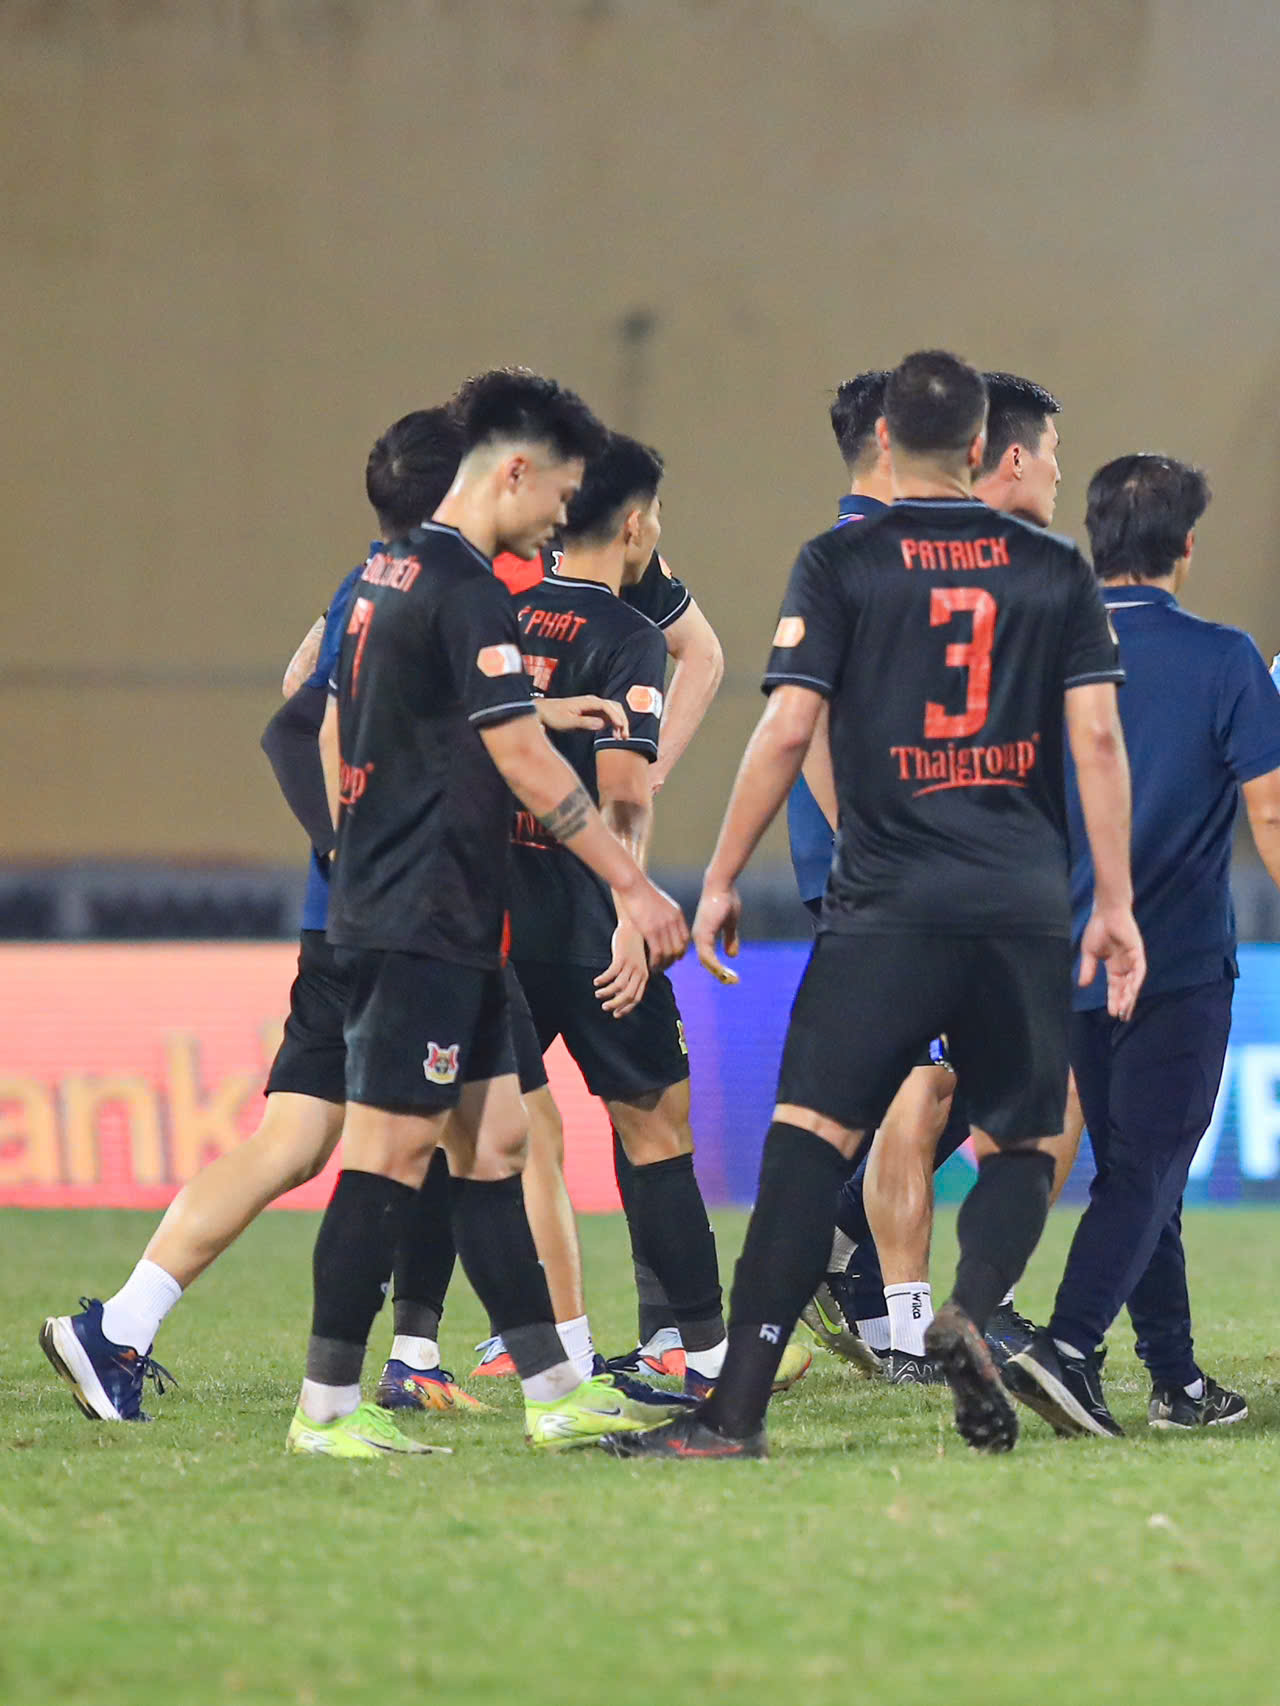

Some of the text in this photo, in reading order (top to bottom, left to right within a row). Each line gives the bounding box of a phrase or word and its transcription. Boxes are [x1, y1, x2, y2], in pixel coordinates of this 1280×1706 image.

[901, 537, 1010, 571] PATRICK
[524, 609, 588, 643] PHÁT
[925, 587, 997, 739] 3
[890, 738, 1037, 785] Thaigroup
[911, 1291, 922, 1320] Wika
